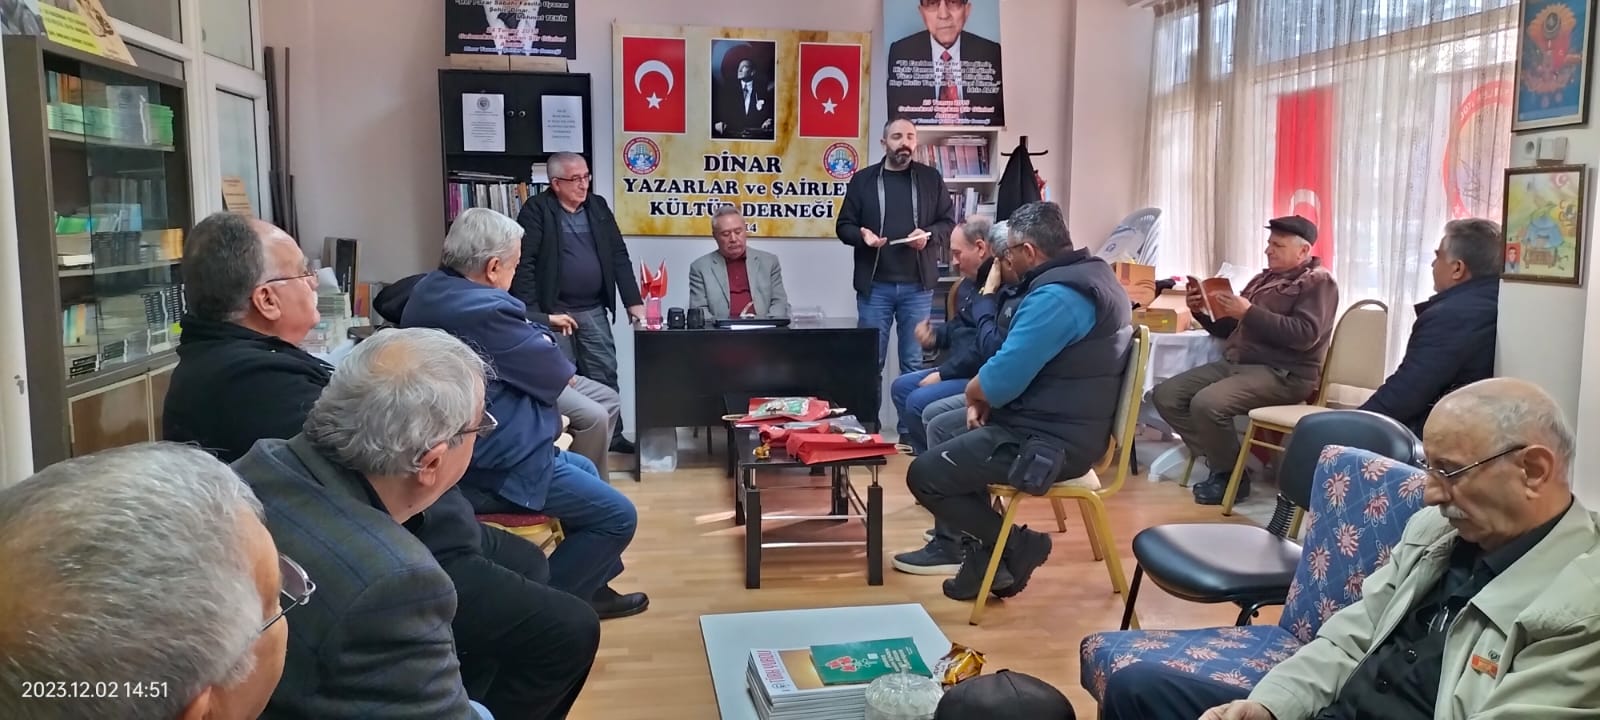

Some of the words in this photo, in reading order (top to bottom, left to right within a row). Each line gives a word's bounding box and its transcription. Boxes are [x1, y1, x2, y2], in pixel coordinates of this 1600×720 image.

[703, 151, 782, 173] DİNAR
[623, 178, 739, 194] YAZARLAR
[745, 184, 766, 195] ve
[772, 178, 850, 199] ŞAİRLE
[650, 198, 734, 216] KÜLTÜ
[743, 200, 833, 218] DERNEĞİ
